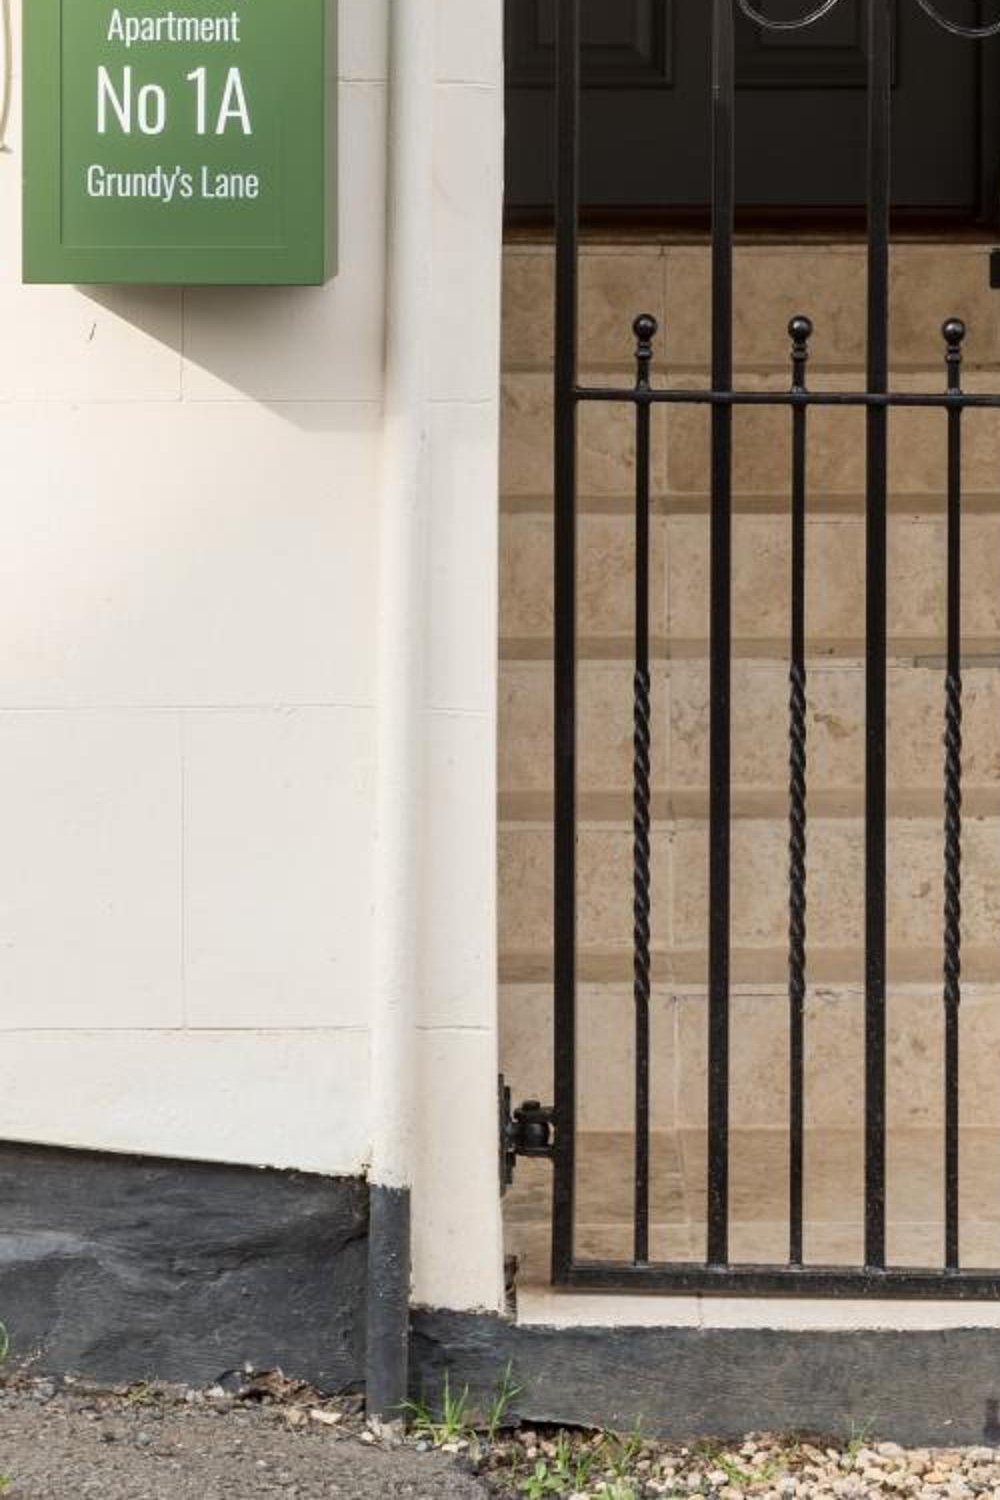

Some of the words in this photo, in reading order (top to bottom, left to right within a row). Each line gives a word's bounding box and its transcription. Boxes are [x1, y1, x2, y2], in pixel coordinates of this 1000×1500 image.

[107, 8, 241, 47] Apartment
[96, 65, 166, 135] No
[186, 66, 253, 135] 1A
[87, 163, 193, 203] Grundy's
[201, 166, 259, 199] Lane
